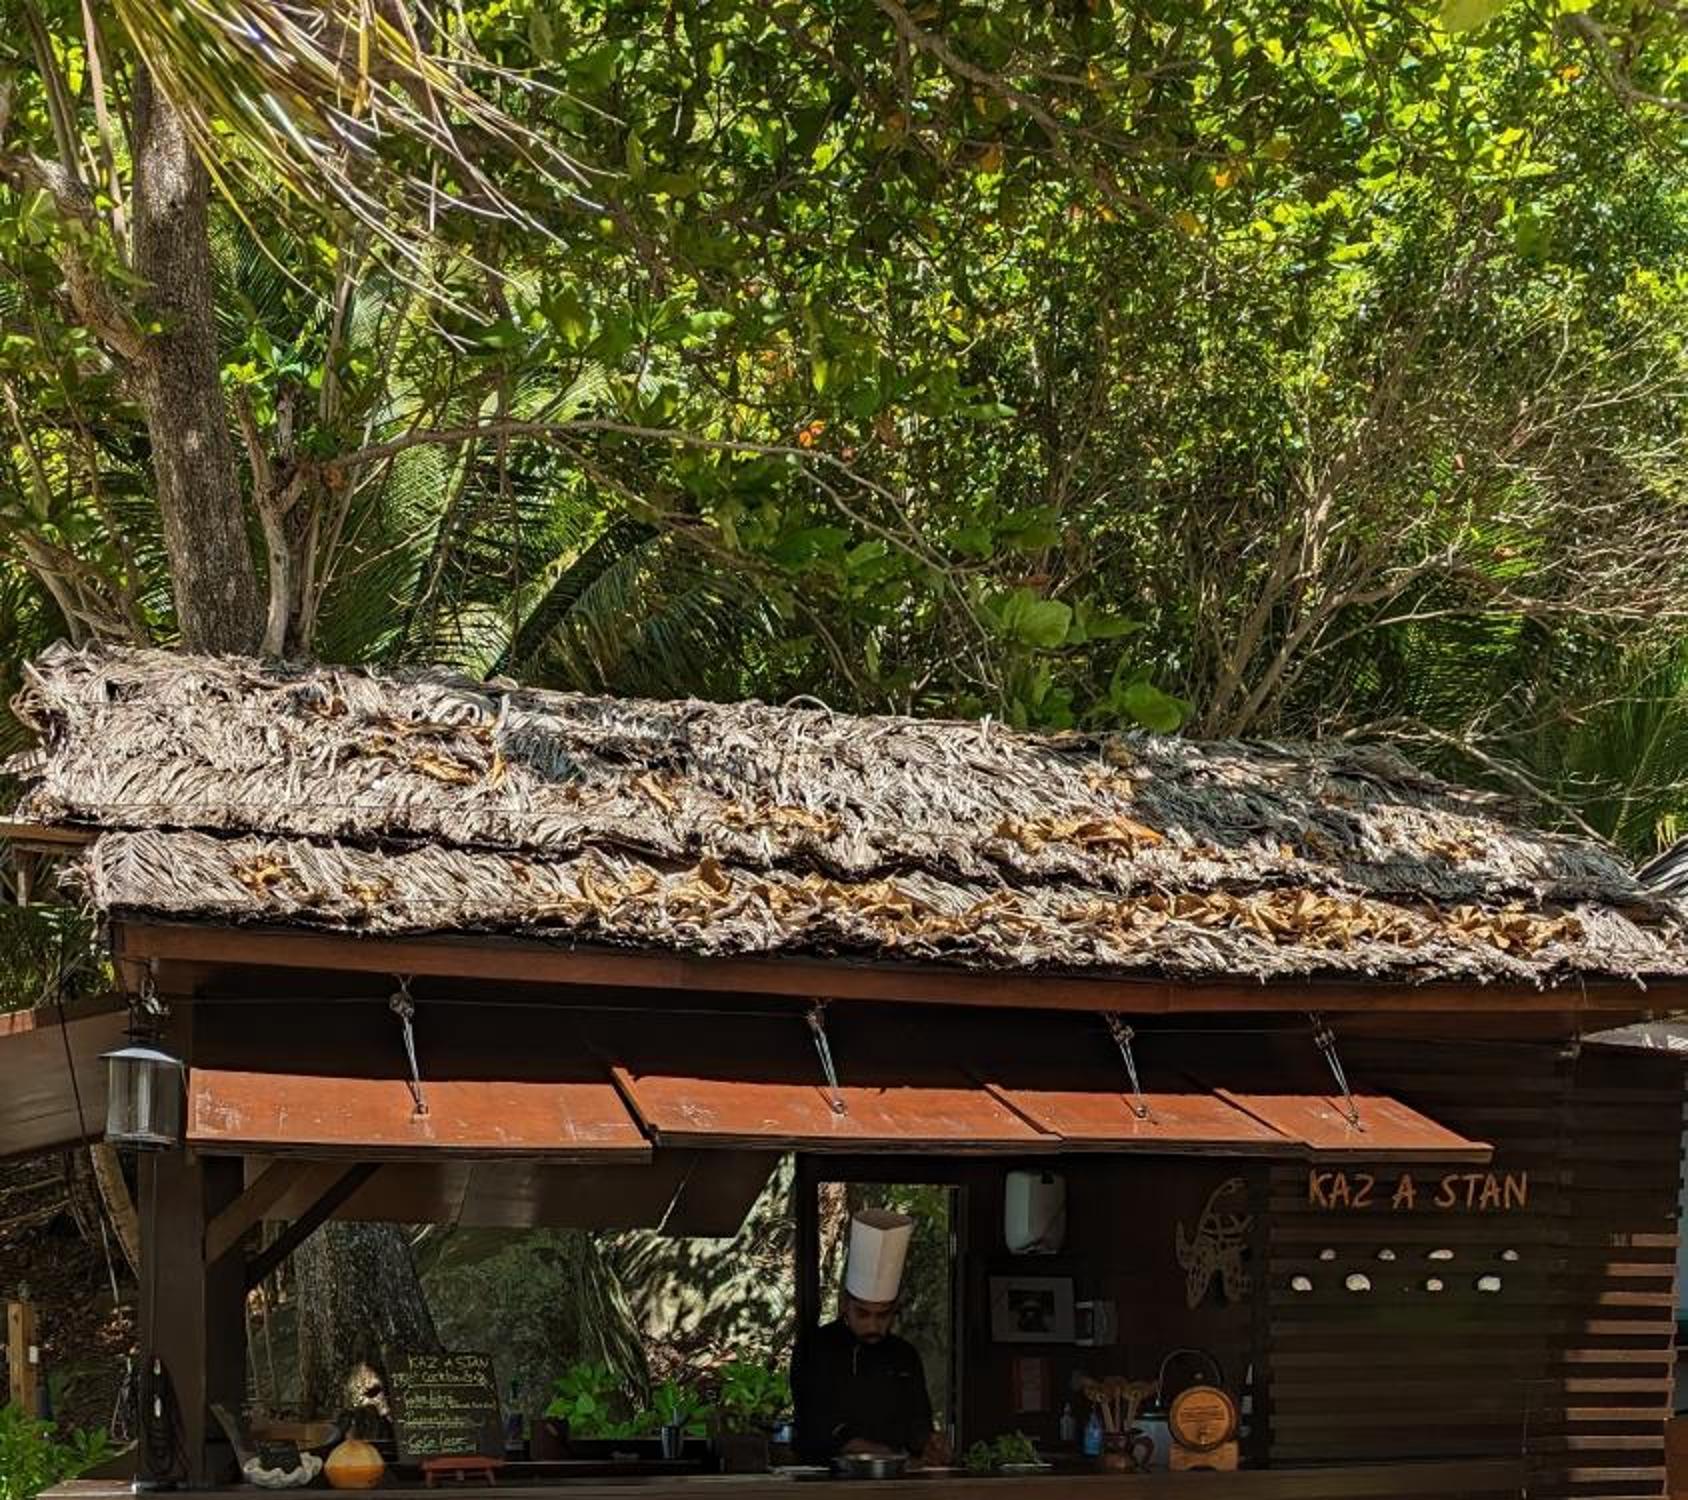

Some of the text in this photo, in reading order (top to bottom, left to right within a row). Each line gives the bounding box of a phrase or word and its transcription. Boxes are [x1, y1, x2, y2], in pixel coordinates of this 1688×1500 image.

[1309, 1169, 1527, 1210] KAZ A STAN
